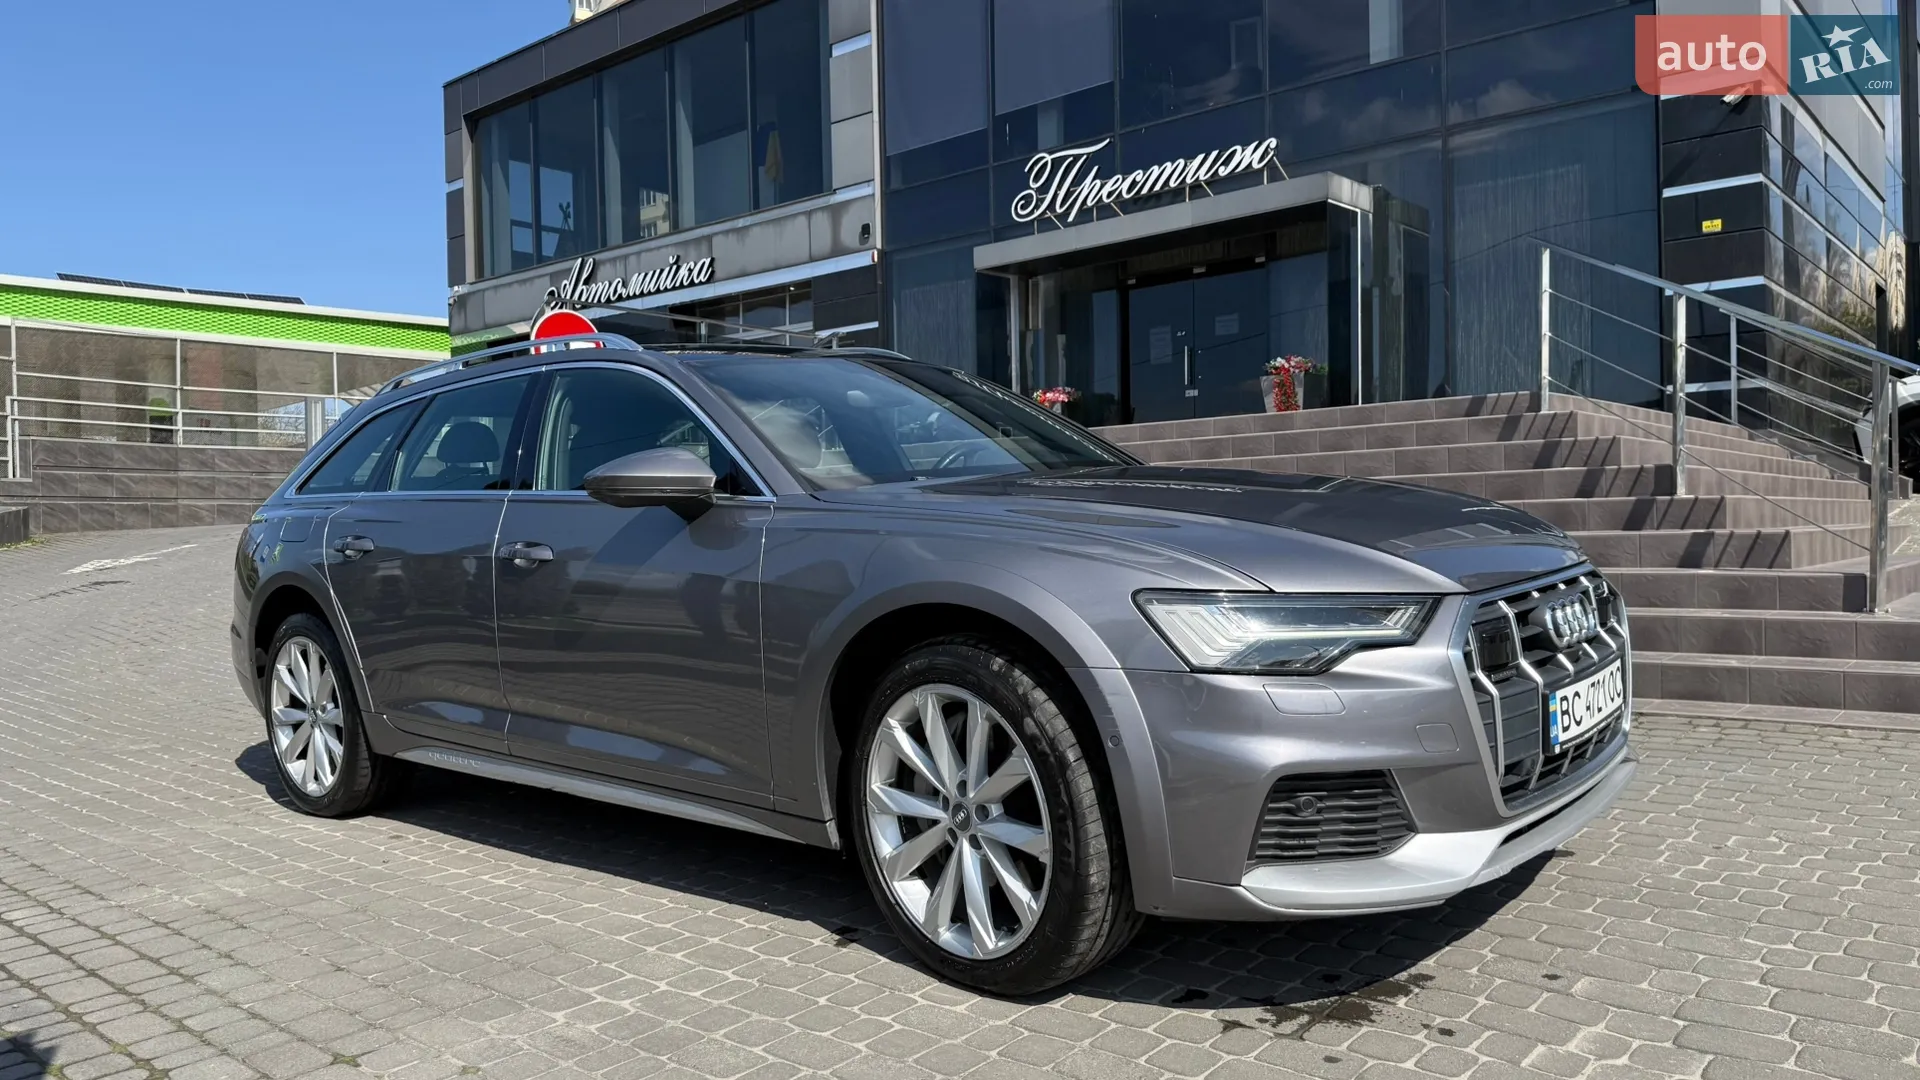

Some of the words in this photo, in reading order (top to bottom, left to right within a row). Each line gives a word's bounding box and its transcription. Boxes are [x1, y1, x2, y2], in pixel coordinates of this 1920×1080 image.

[1011, 137, 1278, 222] Престиж
[544, 255, 713, 308] Автомийка
[1560, 690, 1583, 734] BC
[1585, 674, 1608, 719] 4721
